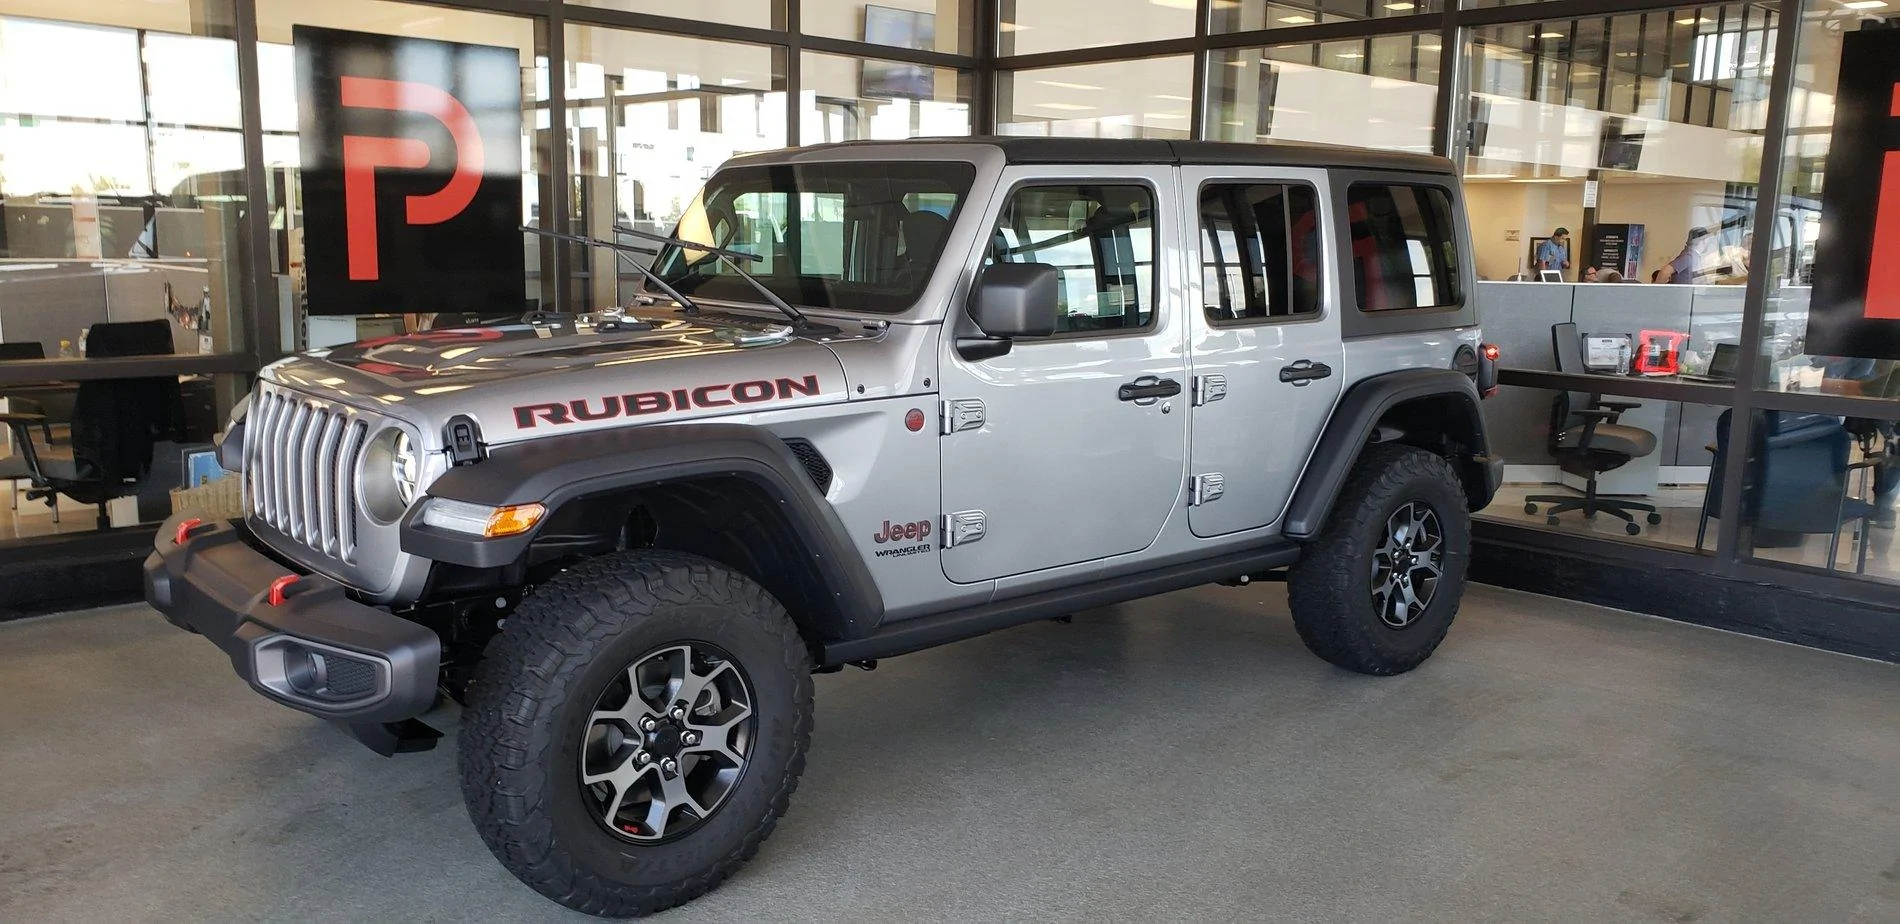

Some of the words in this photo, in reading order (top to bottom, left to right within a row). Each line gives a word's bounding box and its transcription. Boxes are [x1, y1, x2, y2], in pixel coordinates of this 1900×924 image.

[513, 374, 821, 429] RUBICON
[874, 520, 931, 543] Jeep
[875, 544, 930, 557] WRANGLER
